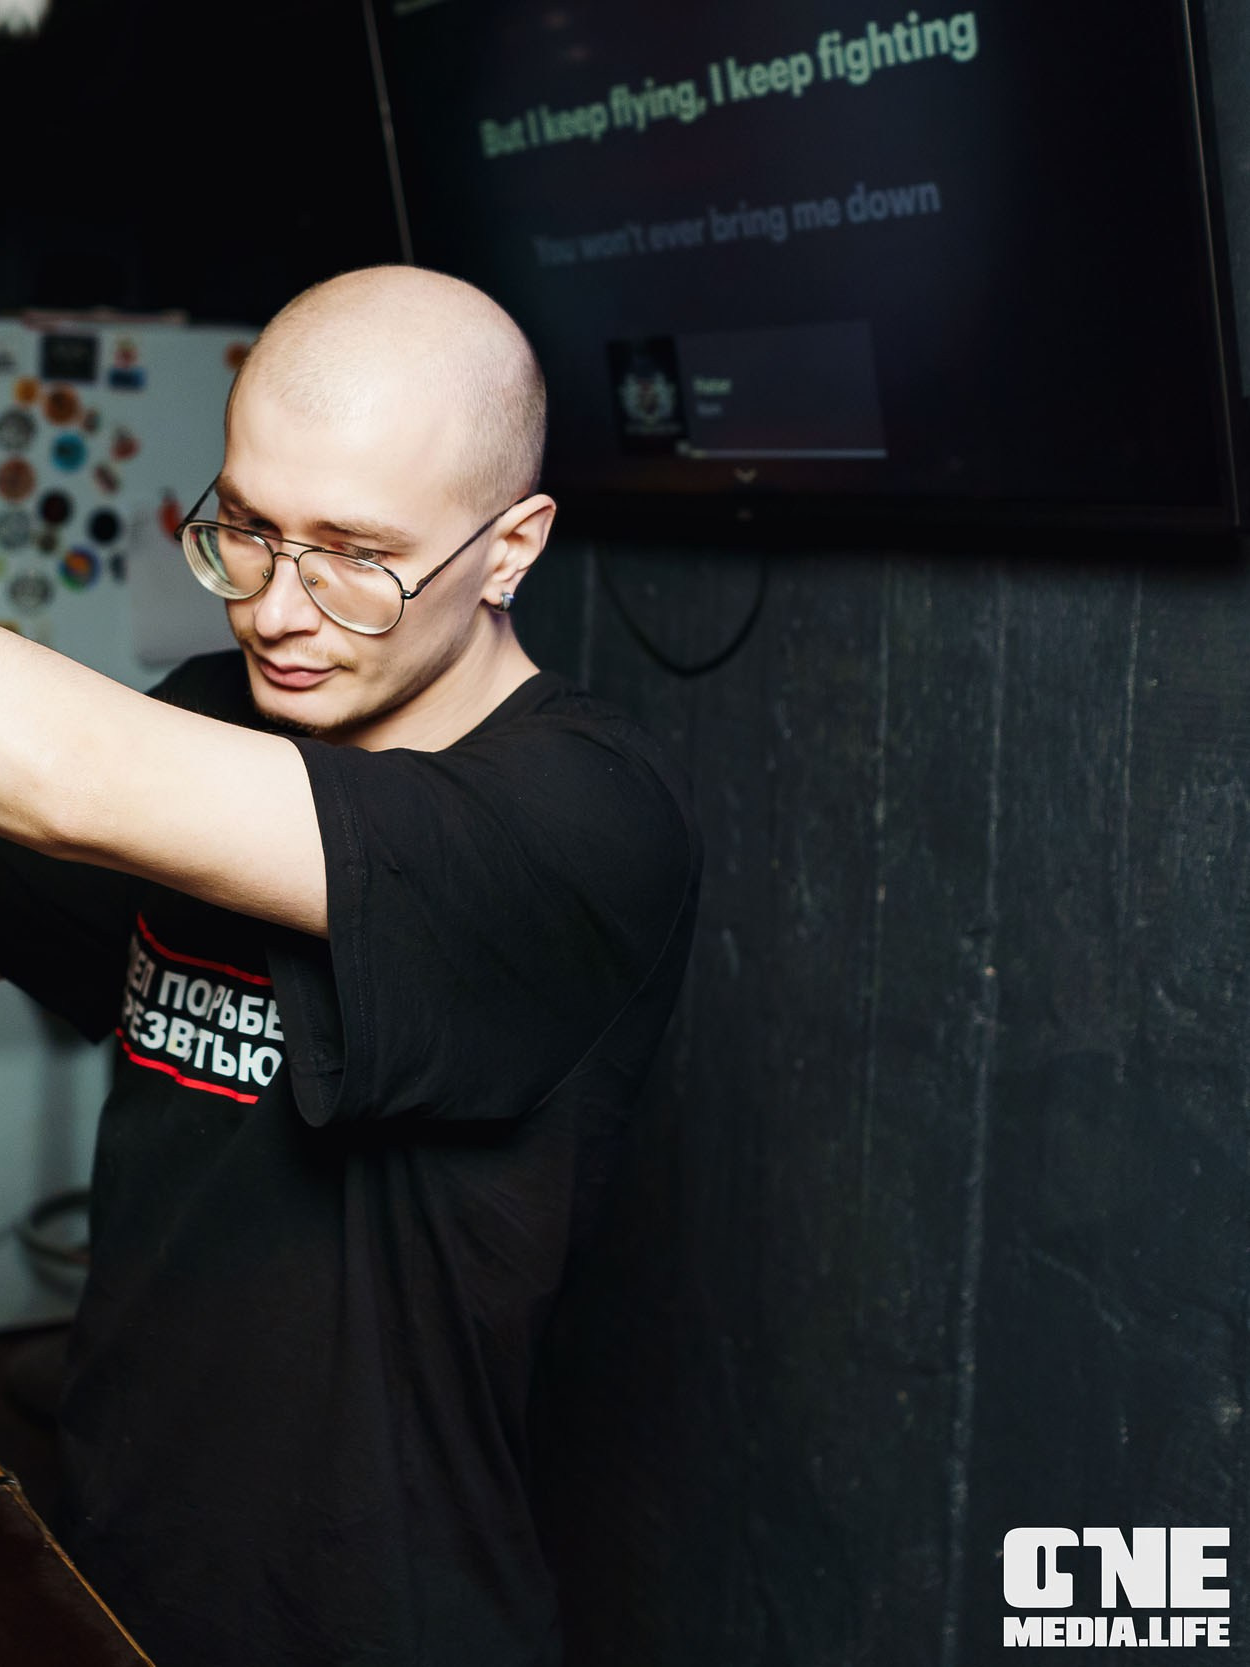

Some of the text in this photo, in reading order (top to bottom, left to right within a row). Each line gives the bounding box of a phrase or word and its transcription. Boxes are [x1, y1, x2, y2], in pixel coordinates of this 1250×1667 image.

[480, 10, 978, 159] But I keep flying, I keep fighting
[649, 218, 704, 250] ever
[709, 202, 788, 242] bring
[792, 197, 841, 231] me
[846, 182, 941, 224] down
